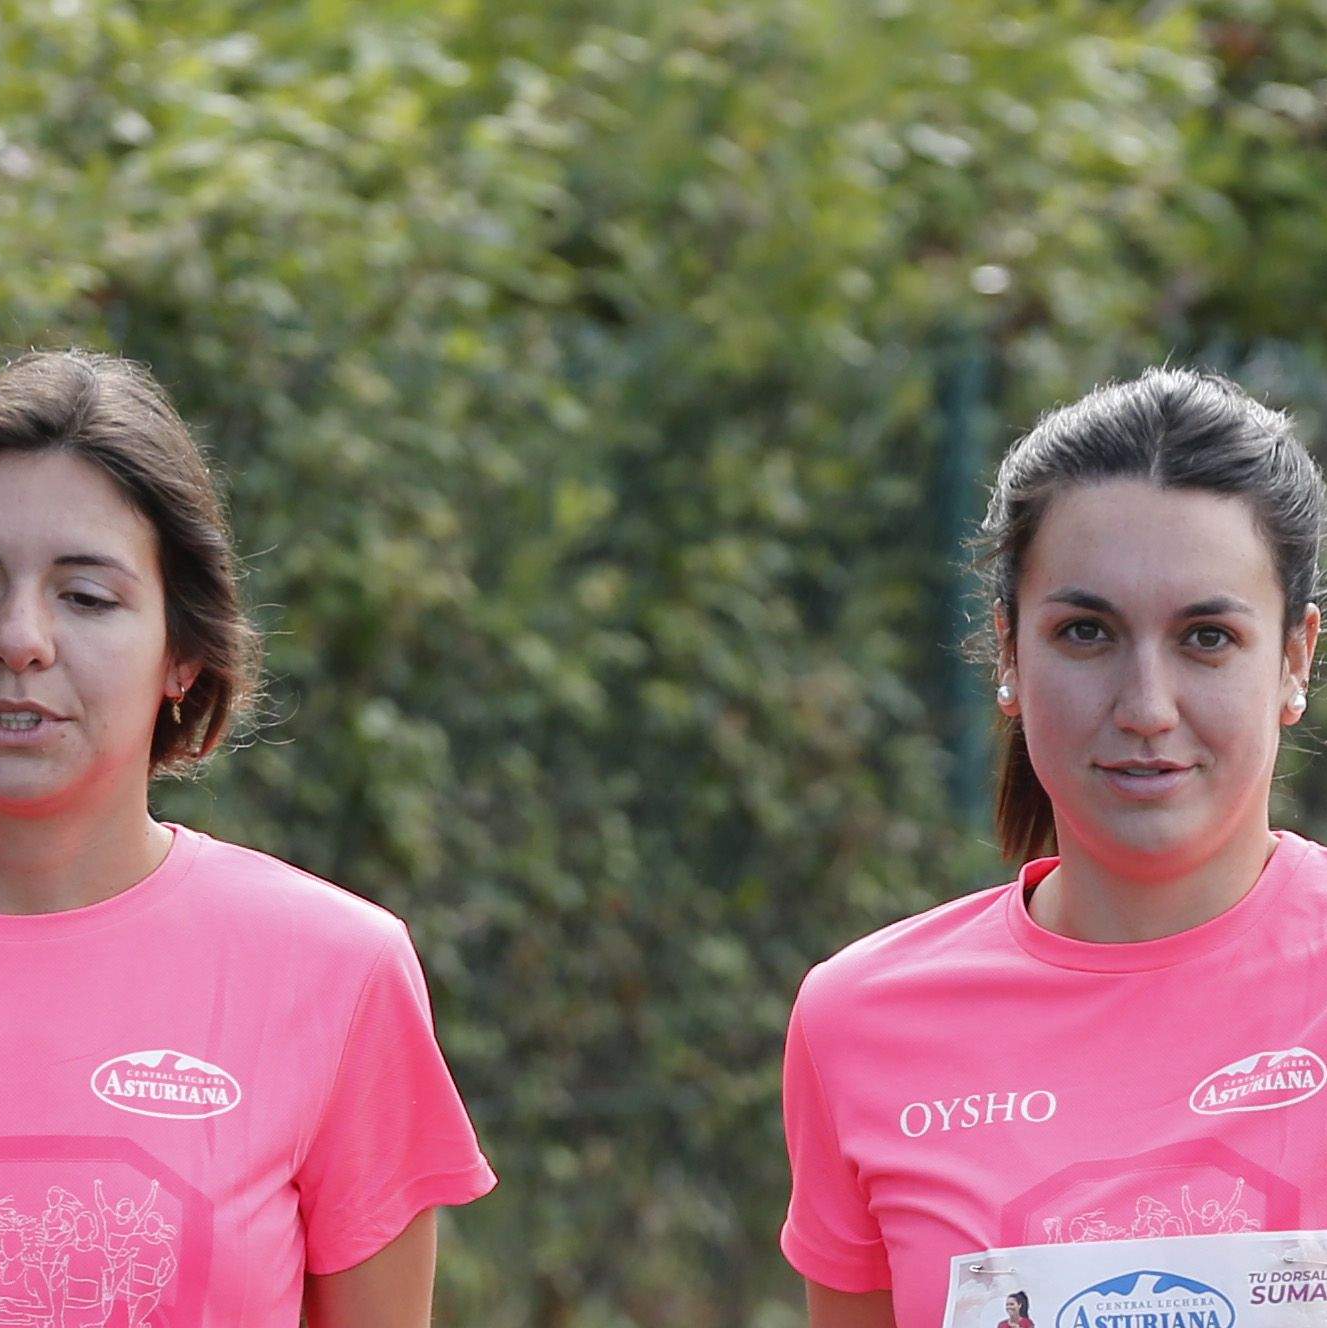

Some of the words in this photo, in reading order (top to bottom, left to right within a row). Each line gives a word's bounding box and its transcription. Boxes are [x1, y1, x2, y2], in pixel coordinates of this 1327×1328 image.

[102, 1069, 230, 1105] ASTURIANA
[126, 1069, 173, 1081] CENTRAL
[178, 1073, 225, 1085] LECHERA
[1199, 1069, 1316, 1109] ASTURIANA
[900, 1090, 1057, 1138] OYSHO
[1248, 1273, 1267, 1284] TU
[1096, 1300, 1153, 1311] CENTRAL
[1158, 1297, 1215, 1308] LECHERA
[1250, 1283, 1327, 1305] SUMA
